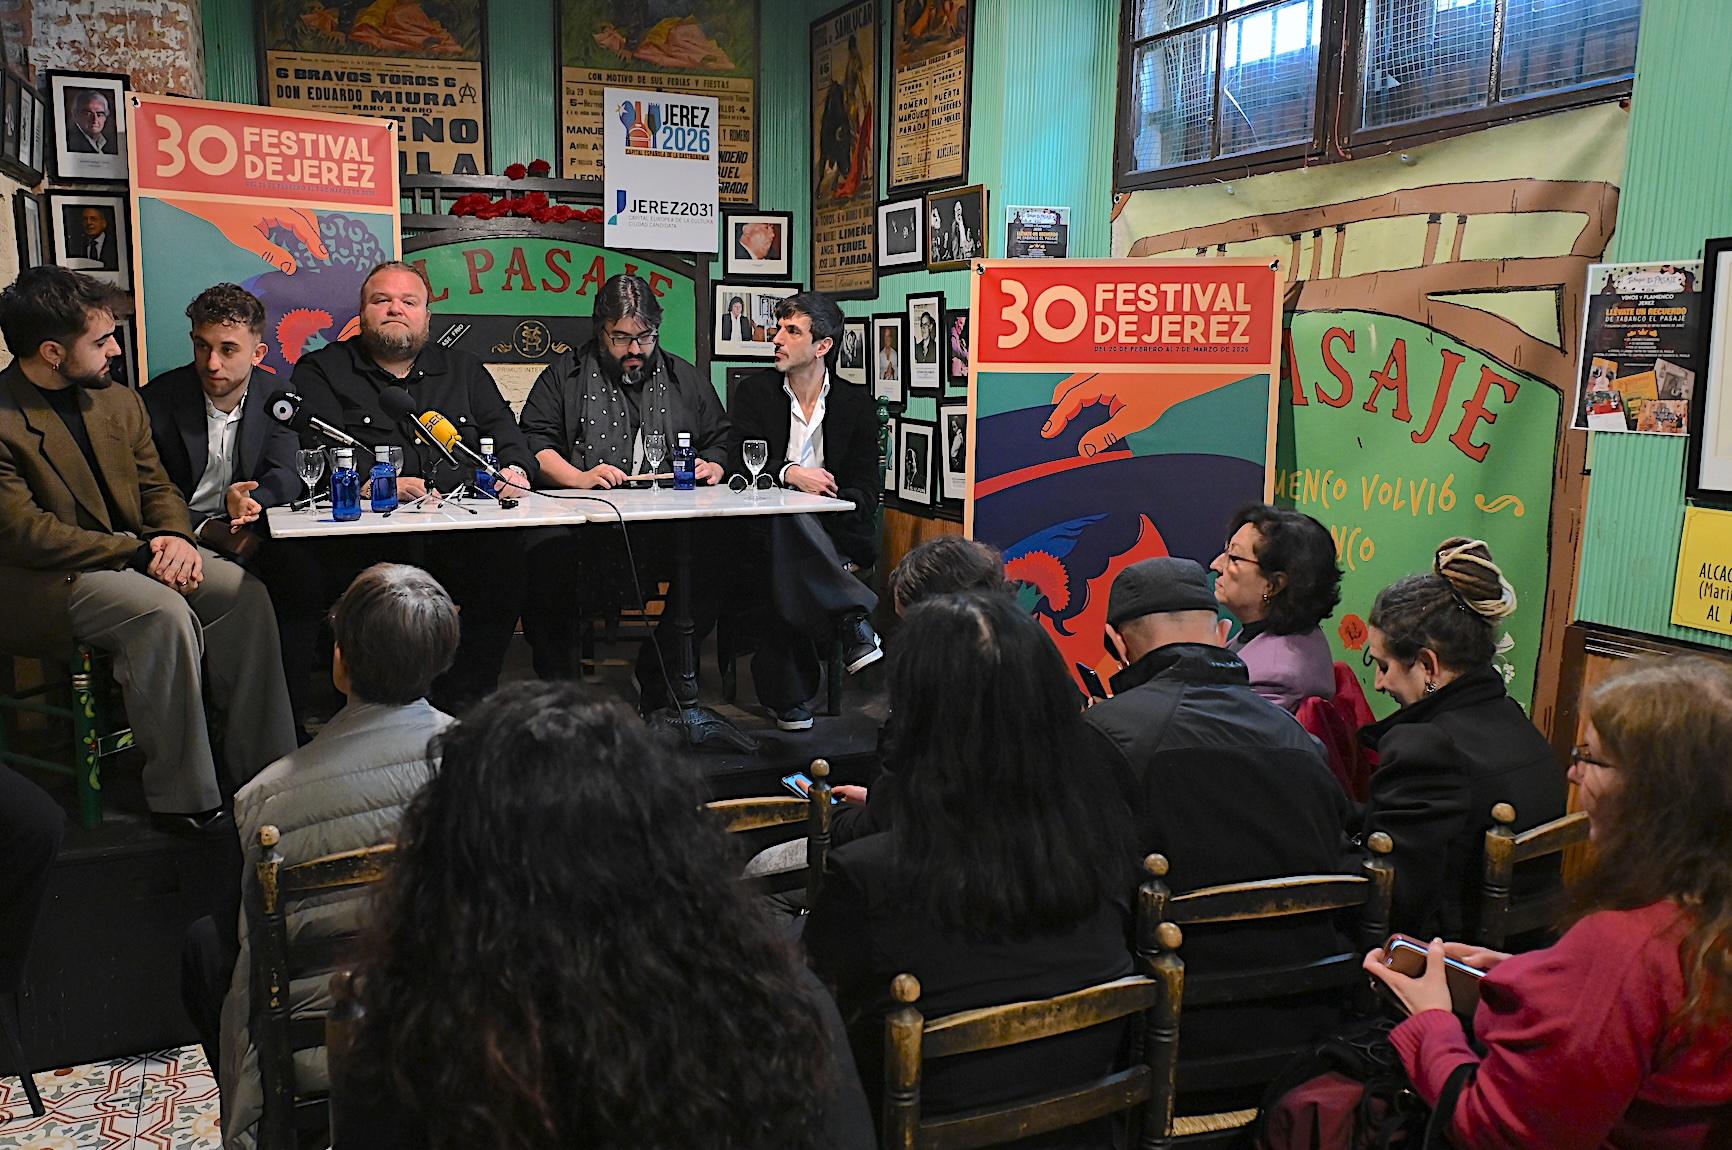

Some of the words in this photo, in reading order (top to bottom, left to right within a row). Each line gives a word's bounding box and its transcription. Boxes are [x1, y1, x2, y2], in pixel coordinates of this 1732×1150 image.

[276, 67, 289, 79] 6
[294, 68, 372, 83] BRAVOS
[376, 73, 439, 87] TOROS
[444, 77, 457, 87] 6
[588, 72, 602, 81] CON
[606, 73, 633, 83] MOTIVO
[638, 75, 646, 84] DE
[650, 76, 663, 86] SUS
[667, 77, 690, 87] FERIAS
[695, 79, 699, 87] Y
[703, 80, 729, 88] FIESTAS
[276, 84, 300, 99] DON
[307, 86, 362, 103] EDUARDO
[370, 89, 457, 107] MIURA
[898, 97, 928, 111] ROMERO
[662, 104, 710, 129] JEREZ
[662, 126, 710, 153] 2026
[899, 122, 926, 135] PARADA
[155, 114, 239, 177] 30
[243, 126, 375, 163] FESTIVAL
[244, 155, 283, 181] DE
[286, 158, 375, 188] JEREZ
[630, 199, 713, 217] JEREZ2031
[837, 240, 867, 254] TERUEL
[840, 252, 872, 266] PARADA
[1094, 282, 1251, 312] FESTIVAL
[997, 279, 1088, 349] 30
[1094, 314, 1139, 344] DE
[1141, 314, 1250, 344] JEREZ
[1699, 580, 1732, 601] (Mari
[1706, 604, 1720, 622] AL
